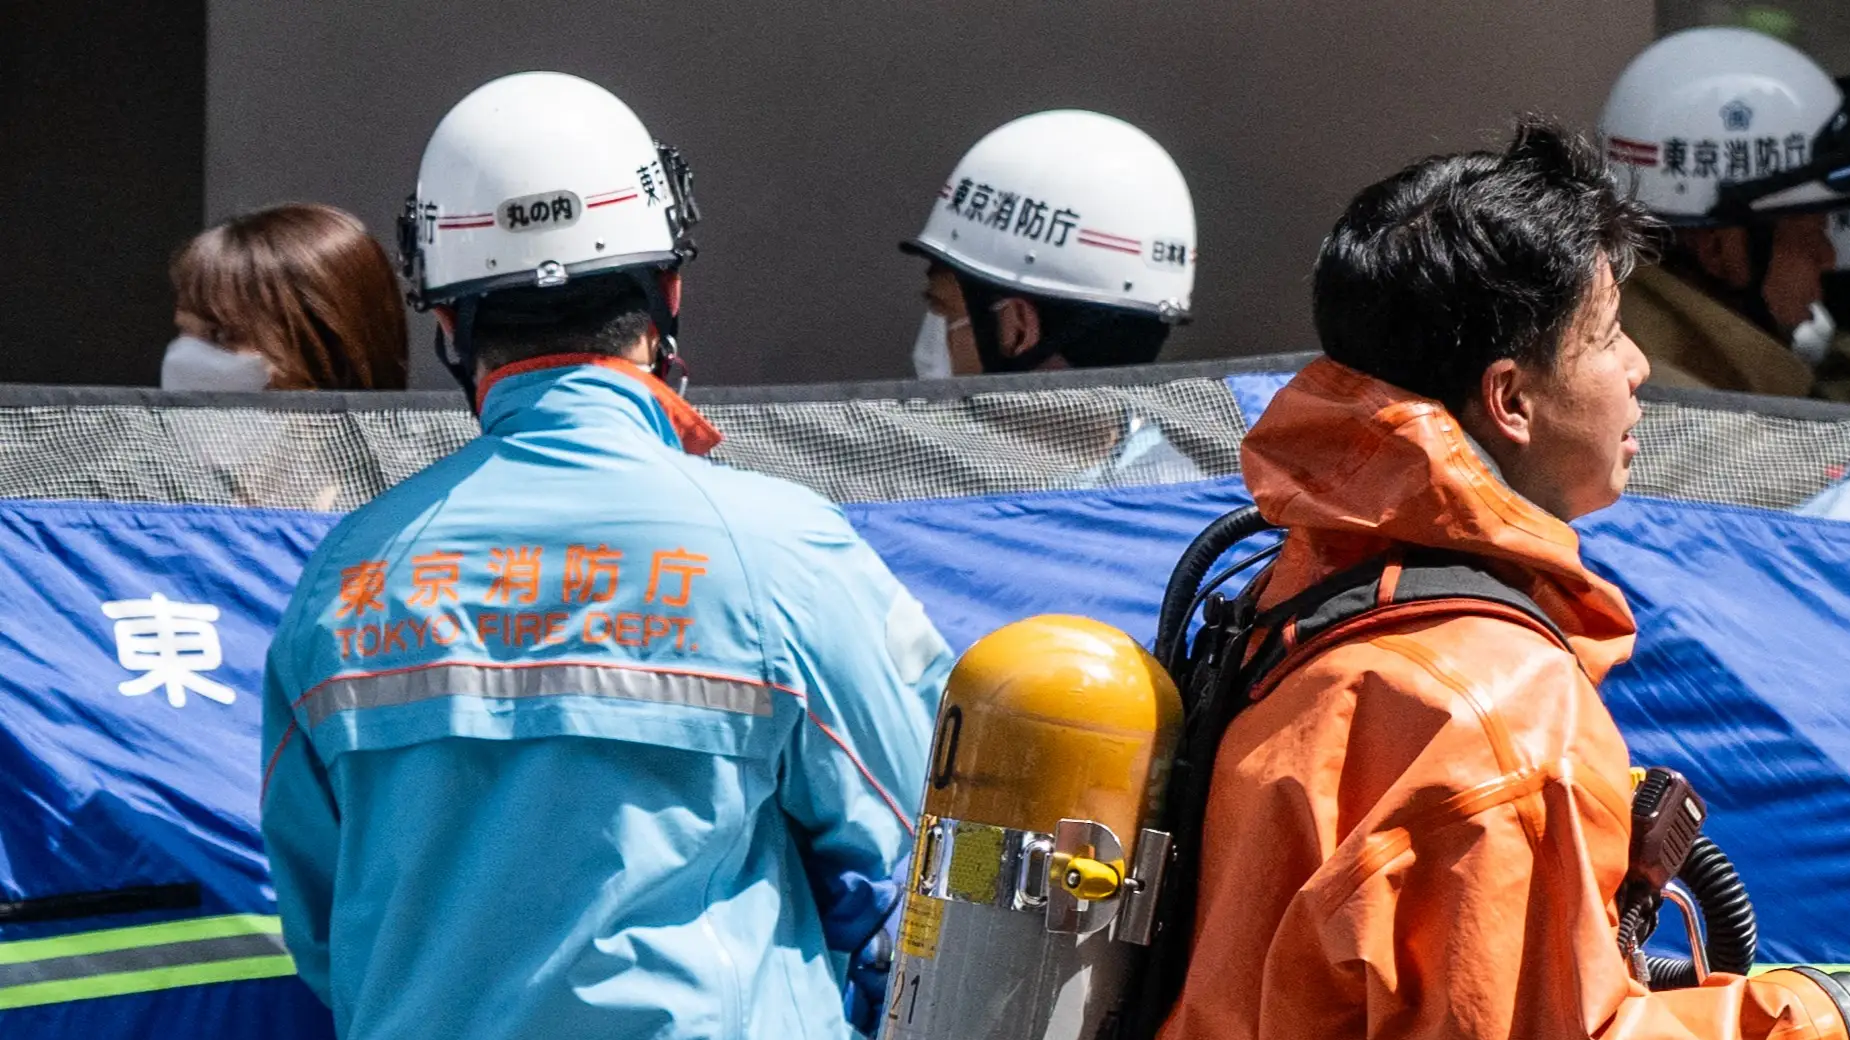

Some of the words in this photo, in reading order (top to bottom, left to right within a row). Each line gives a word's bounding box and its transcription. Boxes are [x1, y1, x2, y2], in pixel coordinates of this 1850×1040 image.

[1661, 132, 1807, 178] 東京消防庁
[507, 196, 573, 229] 丸の内
[947, 177, 1080, 247] 東京消防庁
[335, 544, 710, 618] 東京消防庁
[101, 592, 237, 709] 東
[335, 613, 461, 660] TOKYO
[477, 611, 571, 647] FIRE
[582, 610, 700, 653] DEPT.
